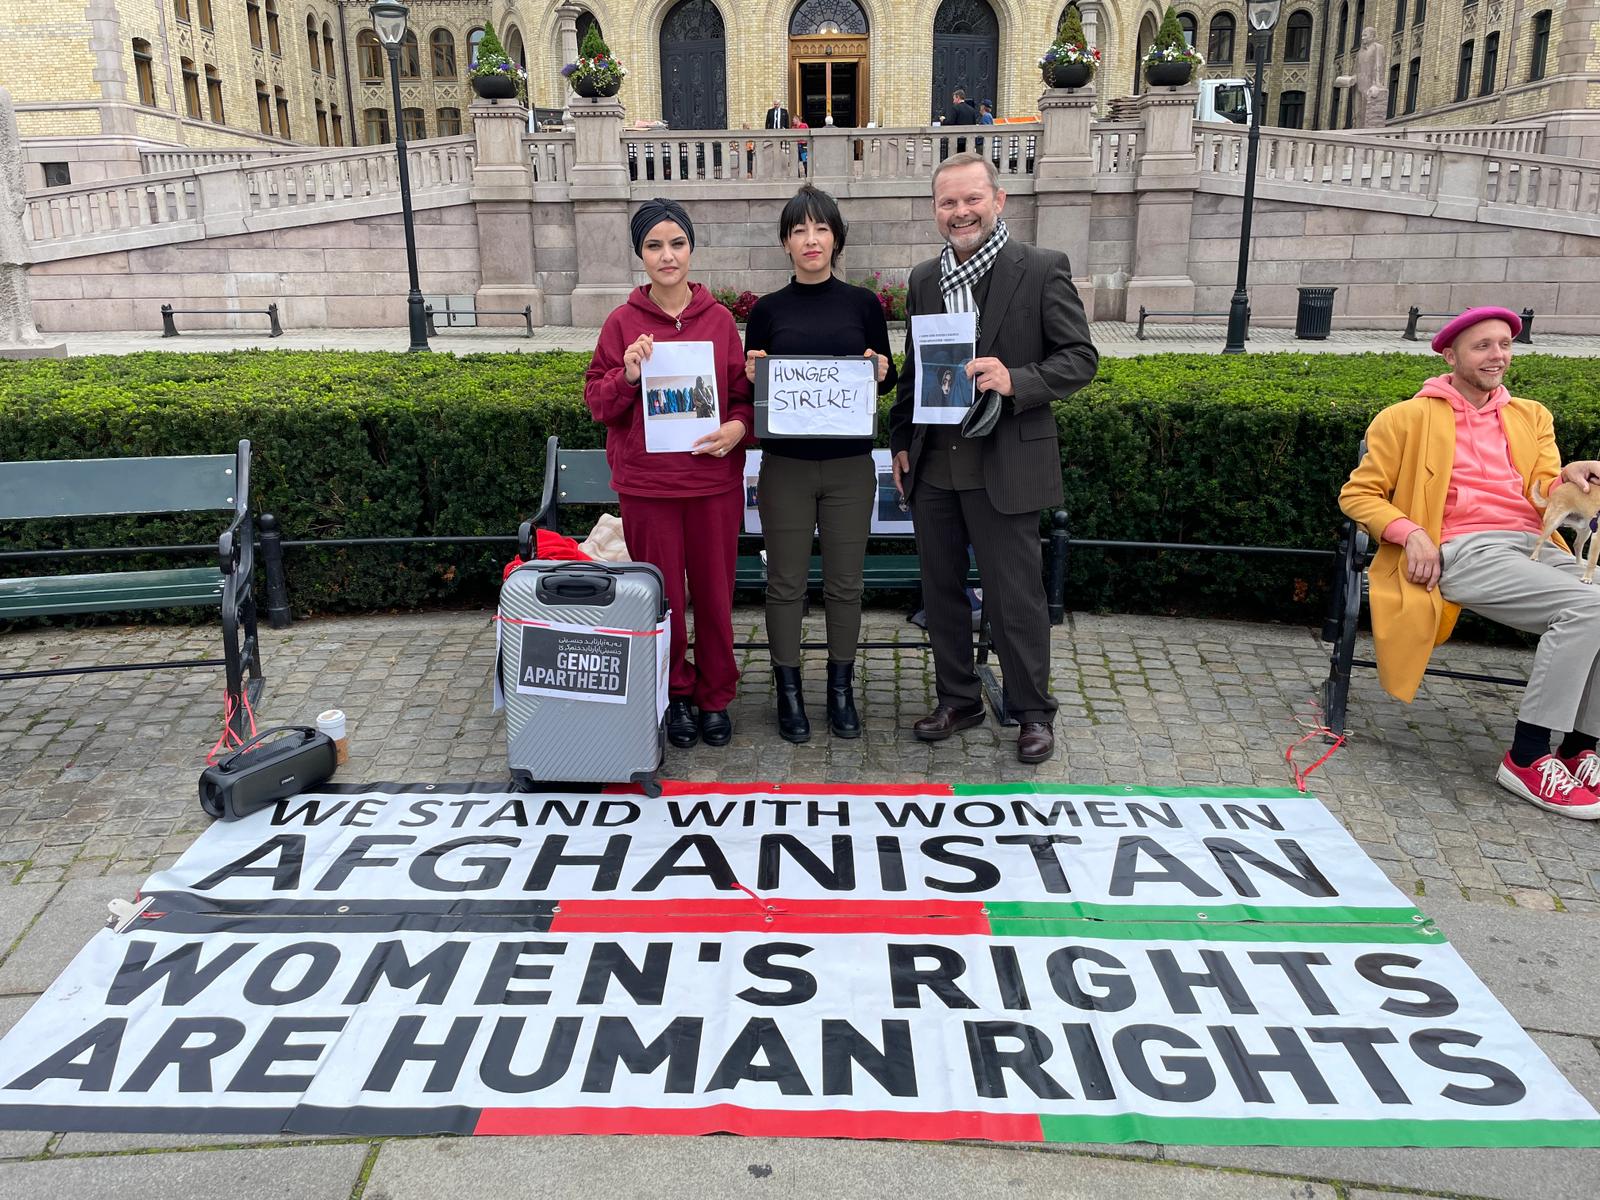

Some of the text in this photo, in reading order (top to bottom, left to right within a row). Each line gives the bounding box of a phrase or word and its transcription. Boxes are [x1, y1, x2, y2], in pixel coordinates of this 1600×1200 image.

[774, 366, 840, 383] HUNGER
[774, 388, 858, 413] STRIKE!
[557, 652, 620, 673] GENDER
[523, 666, 620, 691] APARTHEID
[270, 800, 1285, 831] WE STAND WITH WOMEN IN
[188, 834, 1340, 898] AFGHANISTAN
[104, 941, 1459, 1018] WOMEN'S RIGHTS
[1, 1016, 1526, 1107] ARE HUMAN RIGHTS
